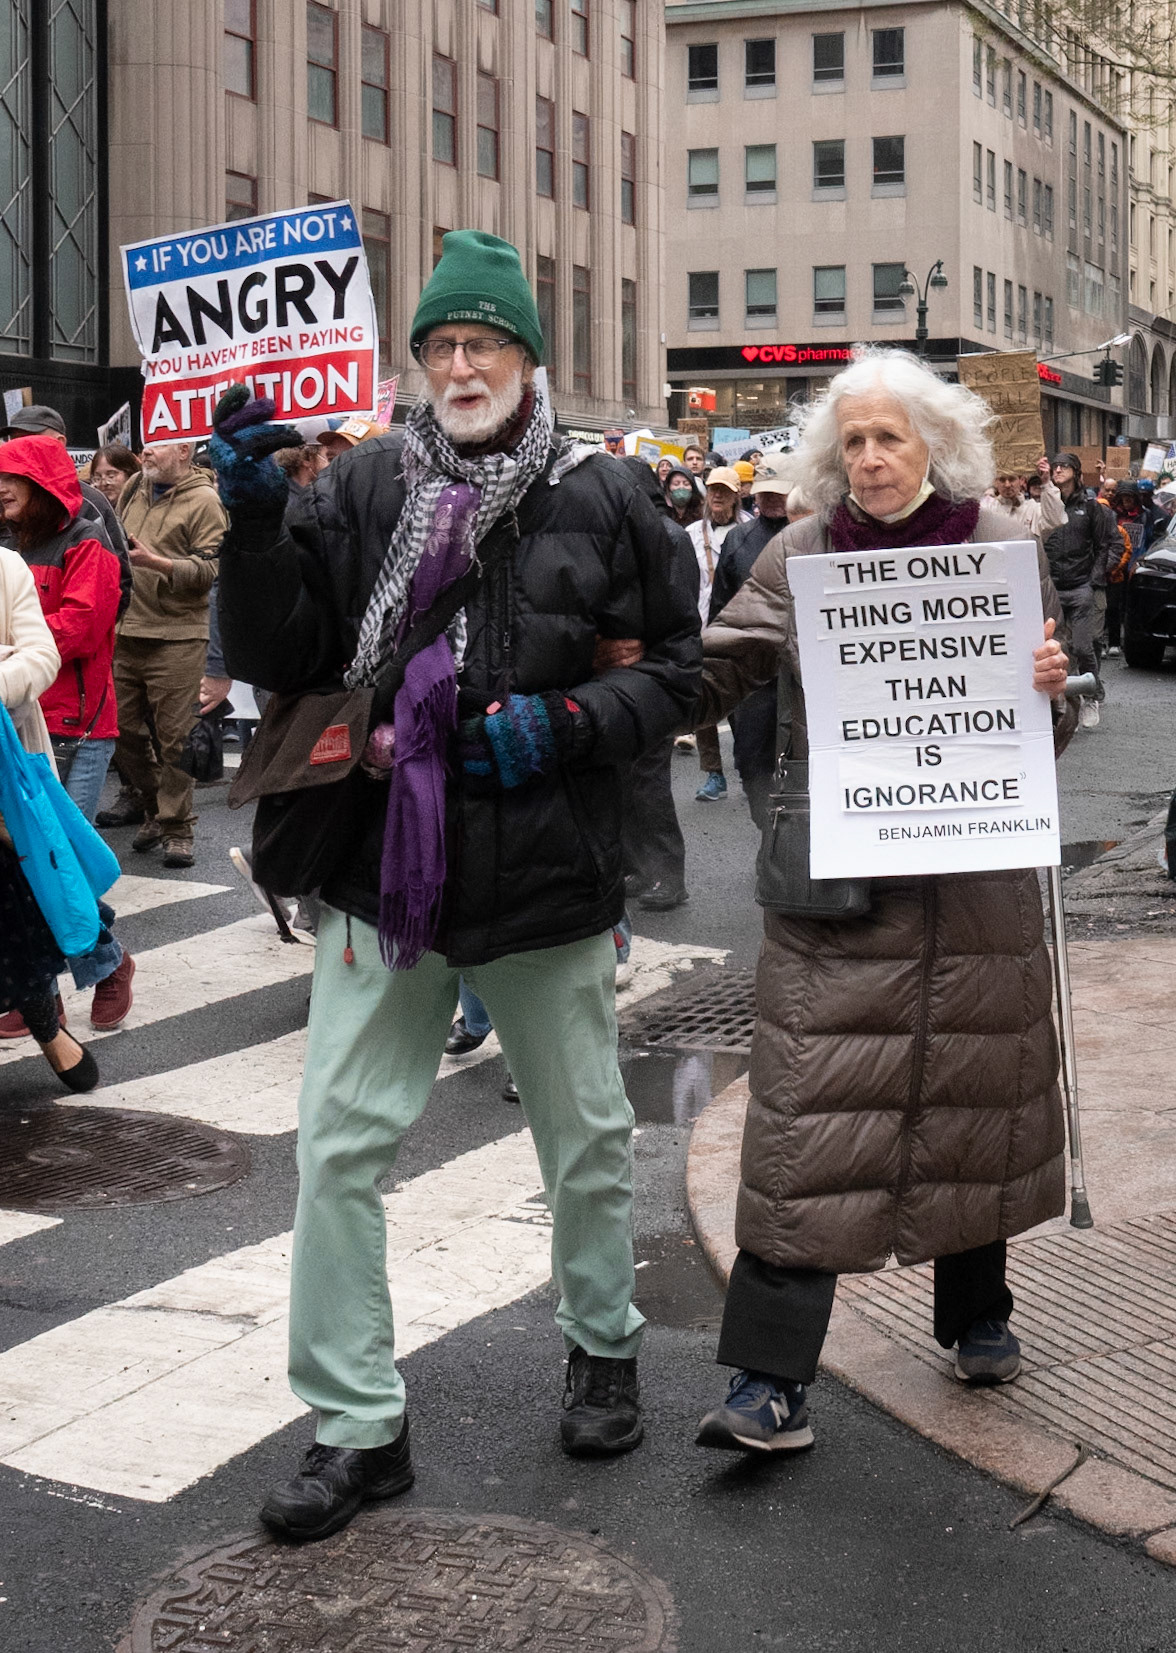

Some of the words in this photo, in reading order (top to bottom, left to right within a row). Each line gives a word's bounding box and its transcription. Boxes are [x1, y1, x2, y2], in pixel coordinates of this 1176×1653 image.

[152, 246, 172, 273] IF
[177, 233, 228, 267] YOU
[235, 222, 277, 257] ARE
[283, 213, 337, 245] NOT
[151, 255, 359, 354] ANGRY
[478, 300, 497, 312] THE
[488, 314, 518, 333] SCHOOL
[148, 356, 183, 377] YOU
[187, 343, 249, 371] HAVEN'T
[251, 335, 293, 357] BEEN
[299, 326, 364, 350] PAYING
[759, 345, 797, 362] CVS
[70, 454, 93, 465] ANDS
[906, 553, 987, 579] ONLY
[820, 602, 912, 630] THING
[921, 593, 1012, 622] MORE
[838, 634, 1008, 666] EXPENSIVE
[884, 675, 968, 701] THAN
[841, 708, 1016, 742] EDUCATION
[916, 744, 942, 767] IS
[878, 823, 963, 841] BENJAMIN
[968, 817, 1051, 836] FRANKLIN
